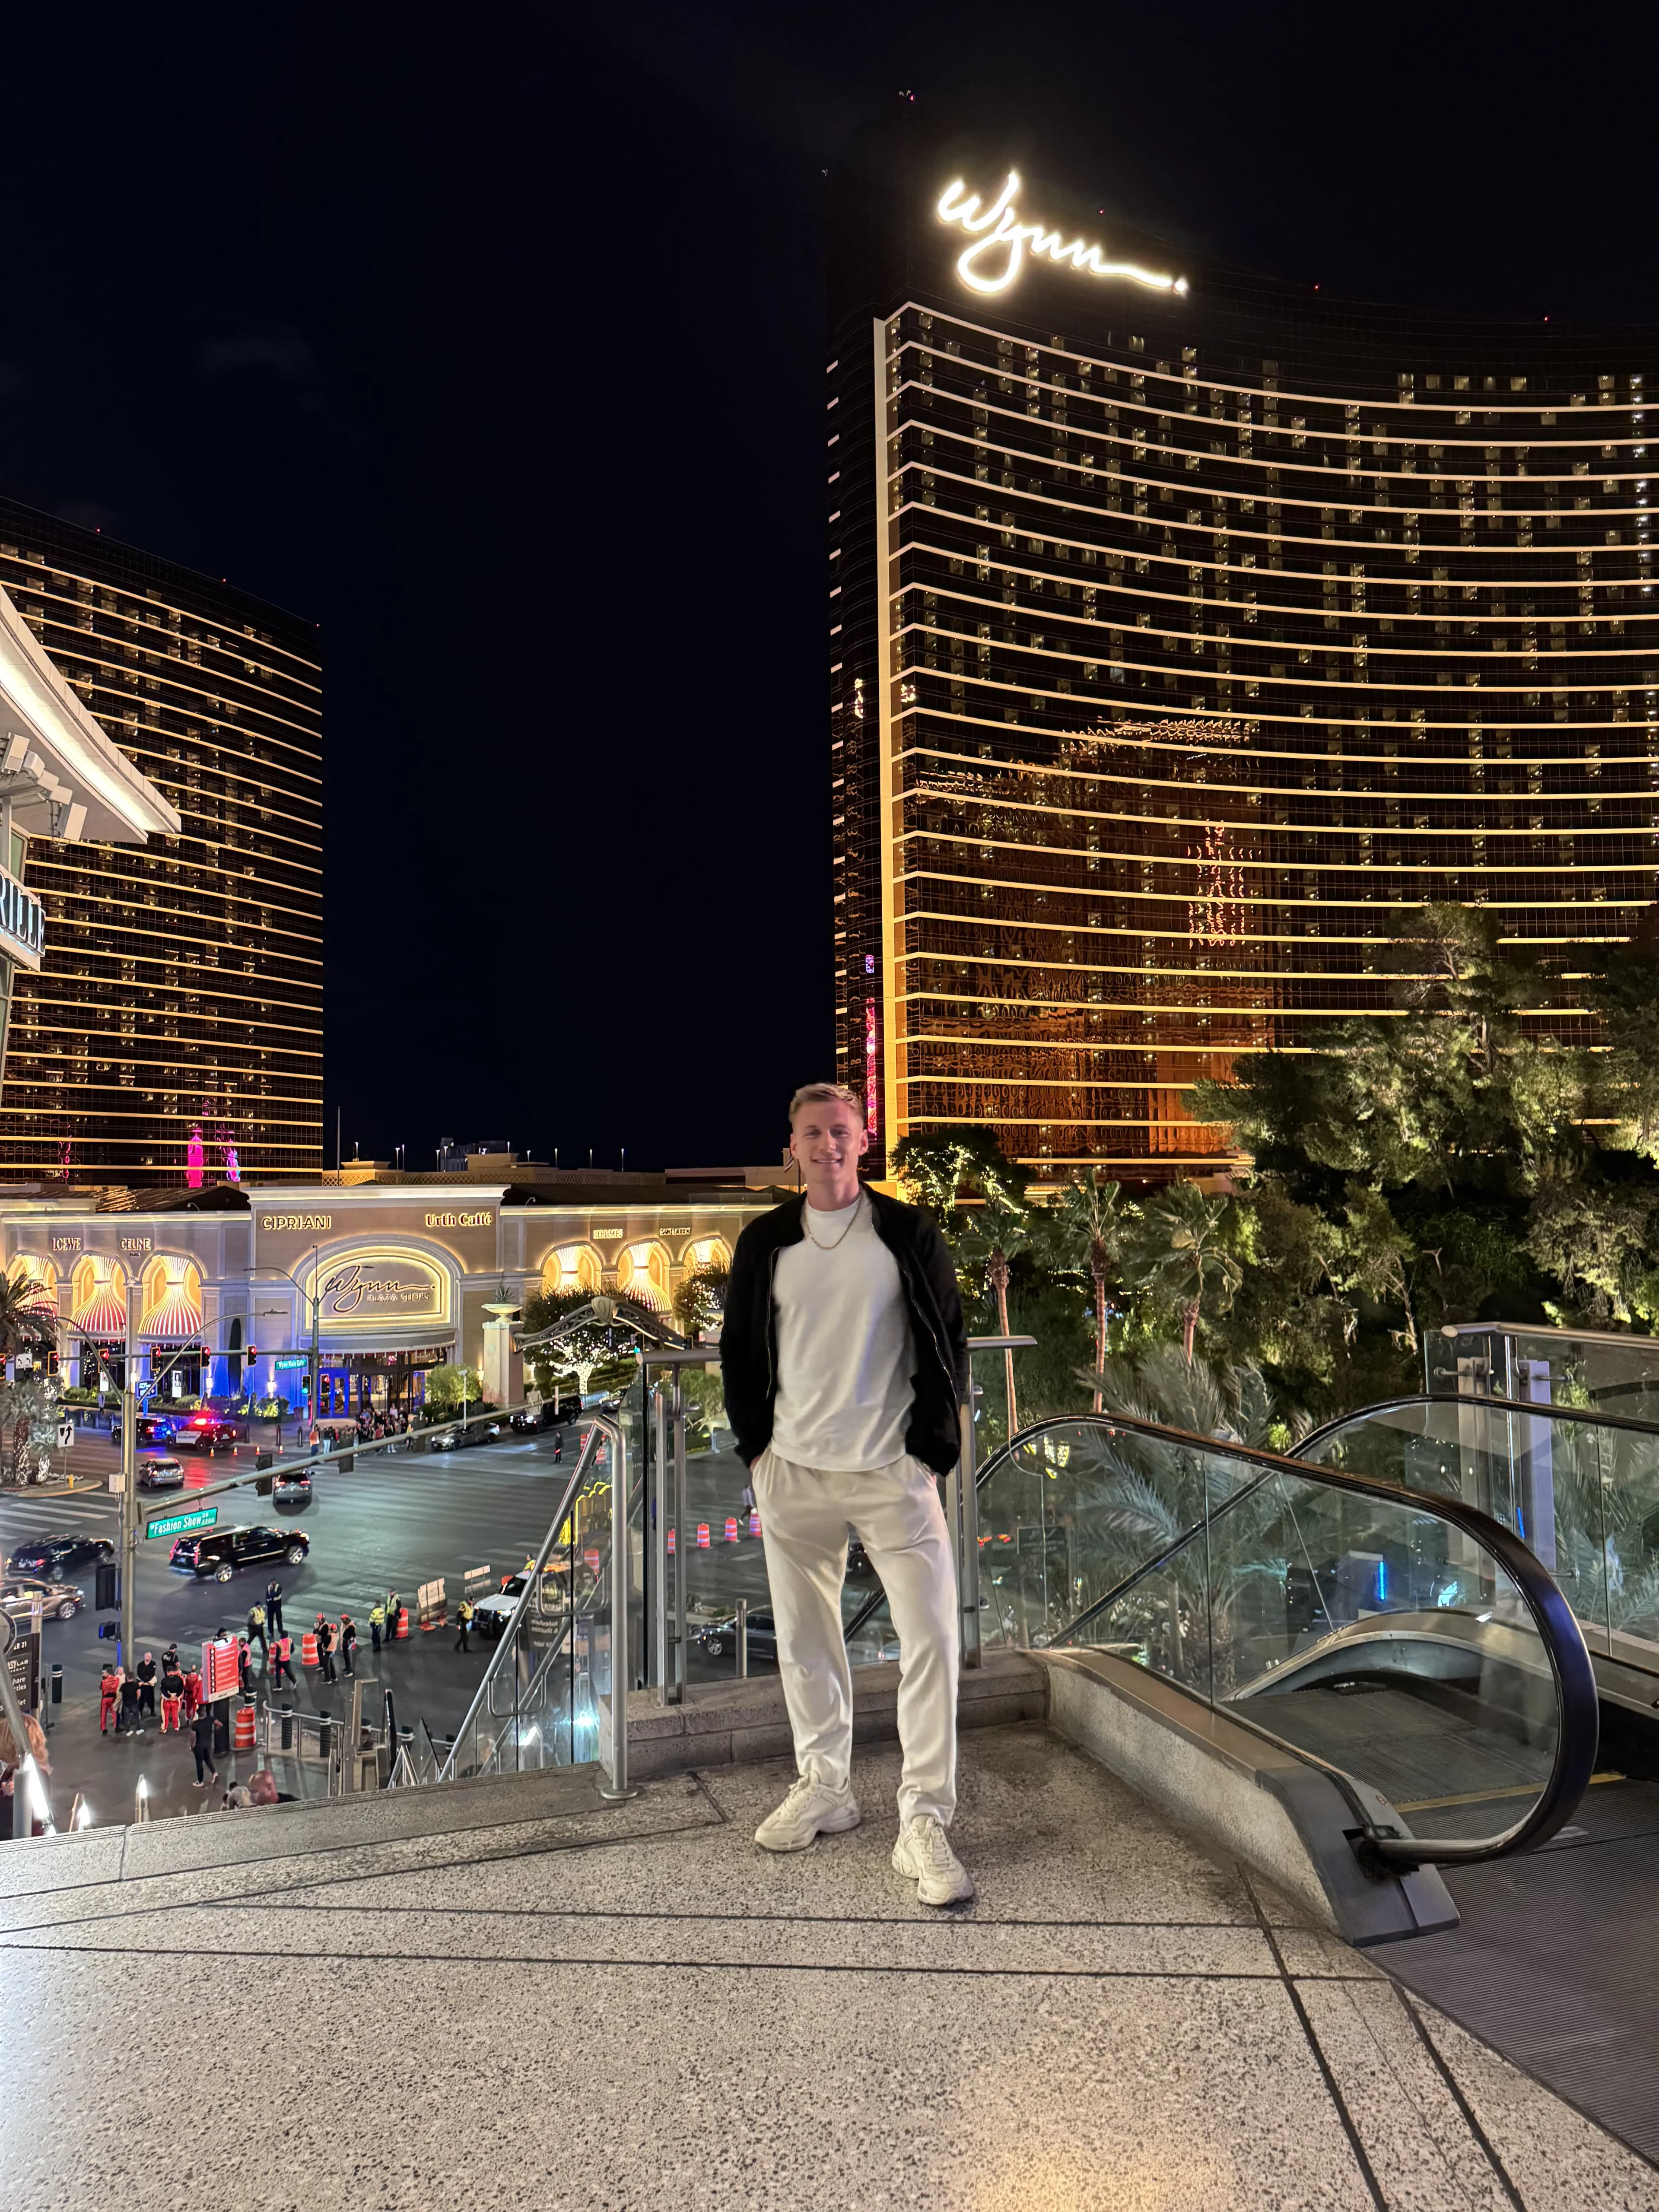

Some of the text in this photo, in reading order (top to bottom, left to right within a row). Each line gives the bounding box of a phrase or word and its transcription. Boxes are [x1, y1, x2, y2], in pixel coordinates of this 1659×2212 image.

[261, 1215, 332, 1230] CIPRIANI
[425, 1213, 456, 1227] Urth
[51, 1237, 81, 1251] LOEWE
[120, 1238, 151, 1250] CELINE
[367, 1292, 430, 1303] PLAZA SHOPS
[154, 1519, 182, 1535] Fashion
[183, 1516, 202, 1528] Show
